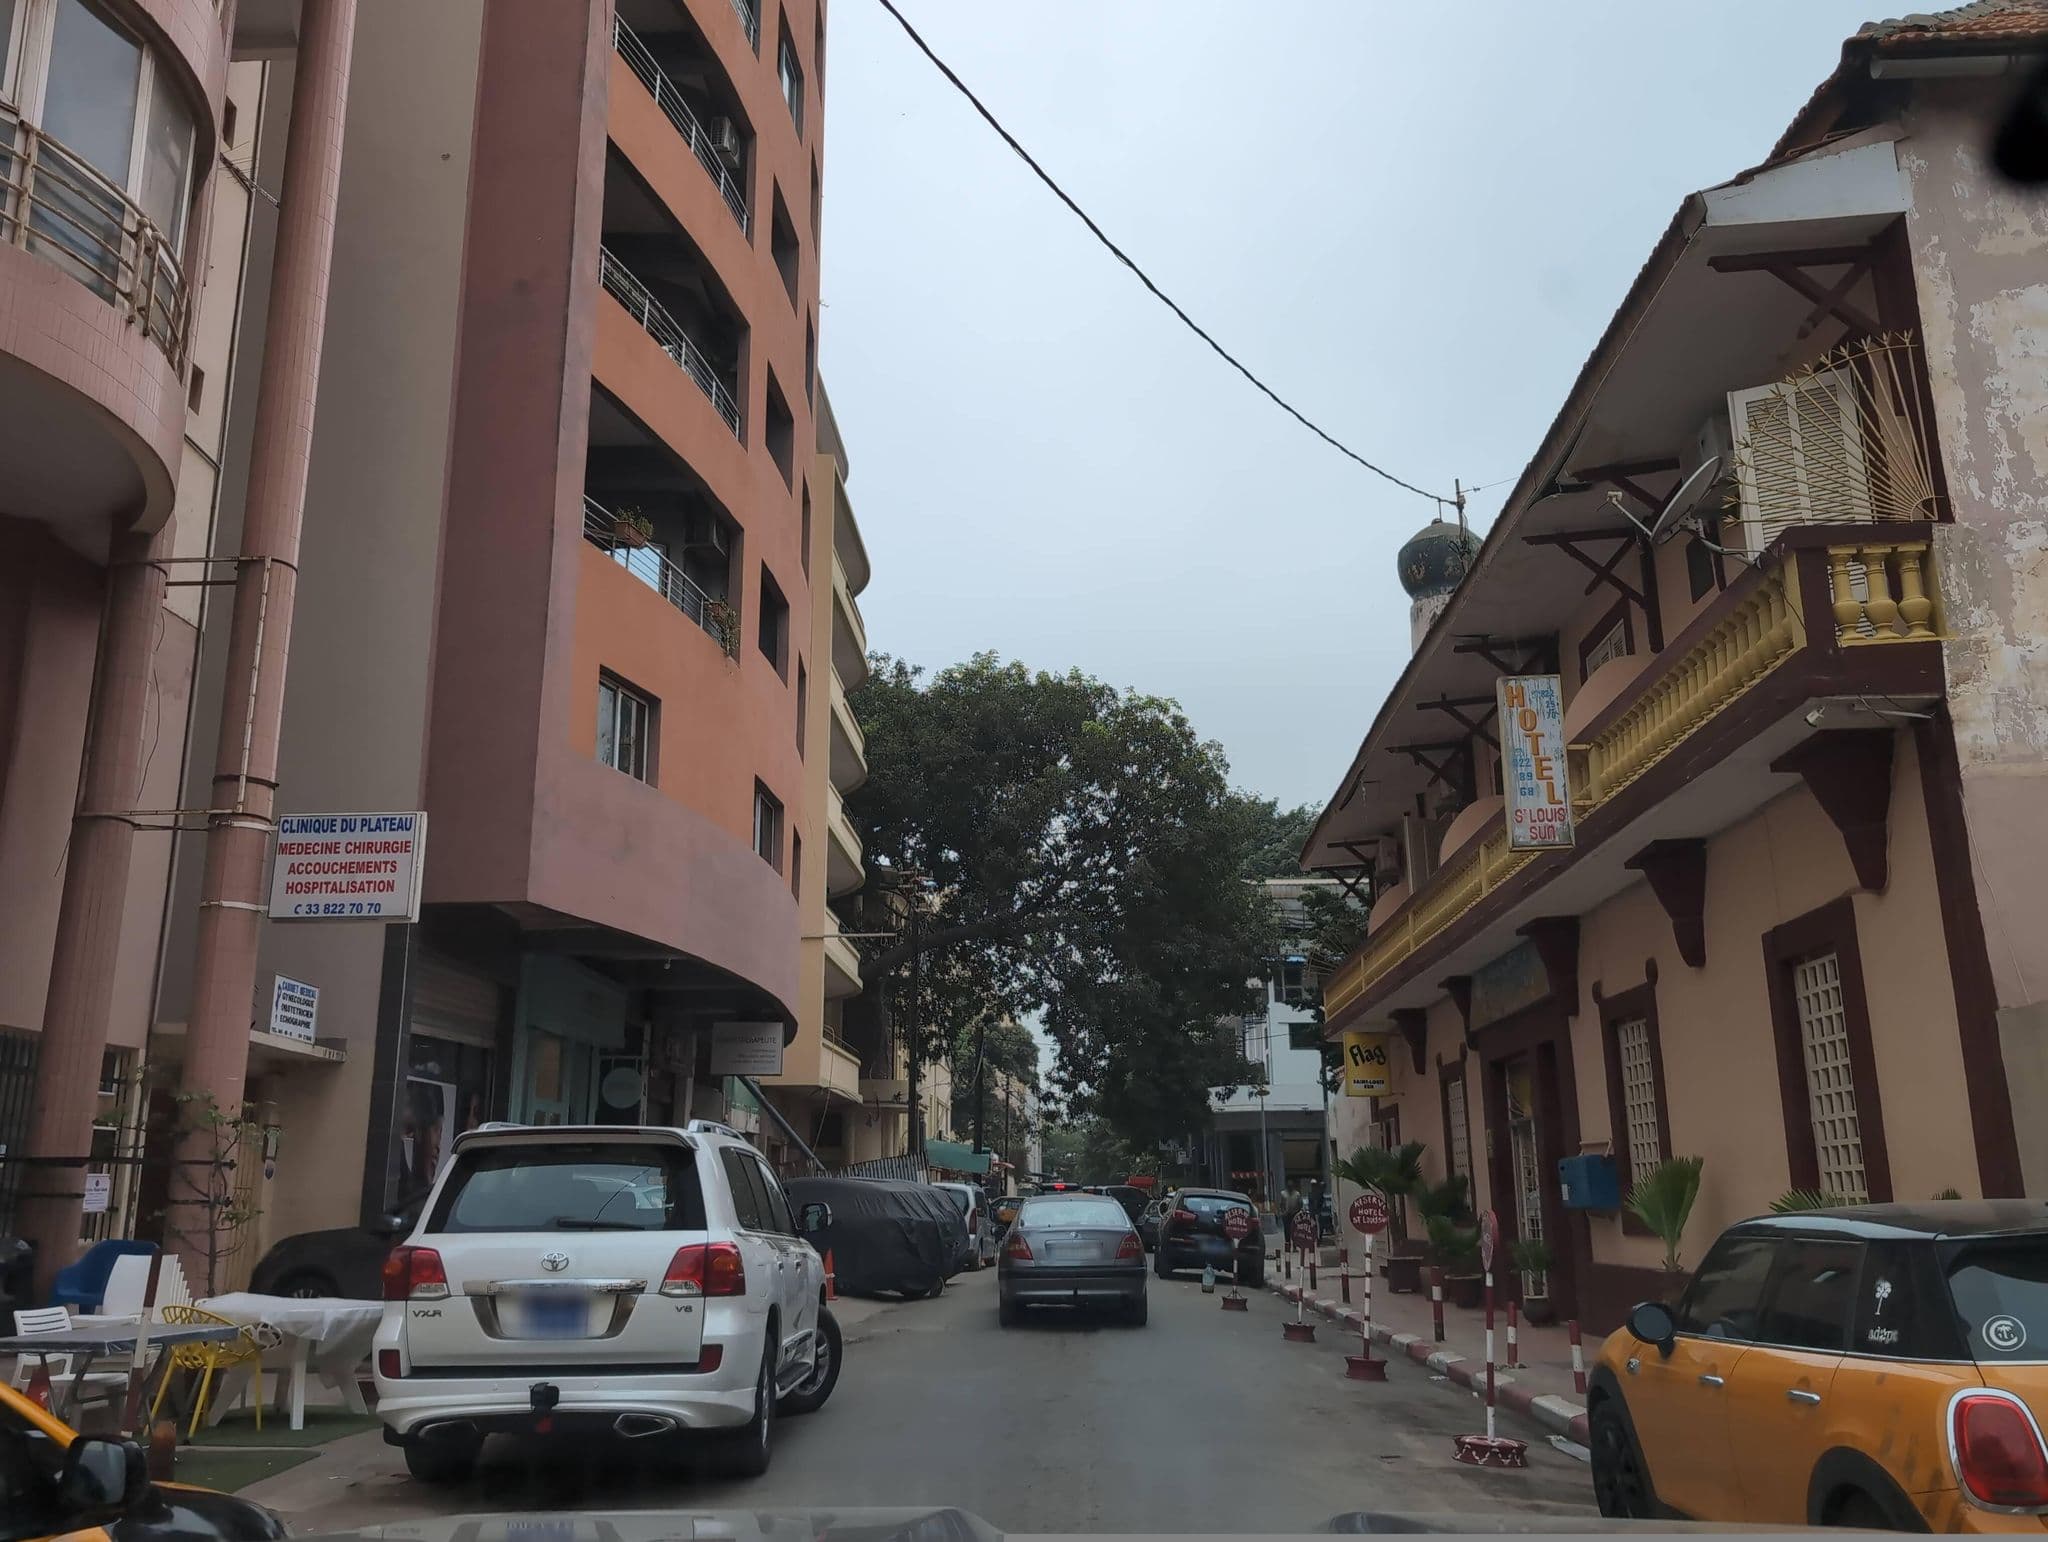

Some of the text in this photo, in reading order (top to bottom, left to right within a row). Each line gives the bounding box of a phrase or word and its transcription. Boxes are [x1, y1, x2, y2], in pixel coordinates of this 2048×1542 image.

[1505, 685, 1563, 804] HOTEL
[1519, 772, 1533, 781] 89
[1520, 787, 1534, 796] 68
[1529, 807, 1566, 823] LOUIS
[281, 816, 412, 834] CLINIQUE DU PLATEAU
[278, 840, 412, 856] MEDECINE CHIRURGIE
[287, 860, 398, 875] ACCOUCHEMENTS
[285, 879, 396, 895] HOSPITALISATION
[305, 902, 382, 914] 33 822 70 70
[1358, 1208, 1384, 1217] HOTEL
